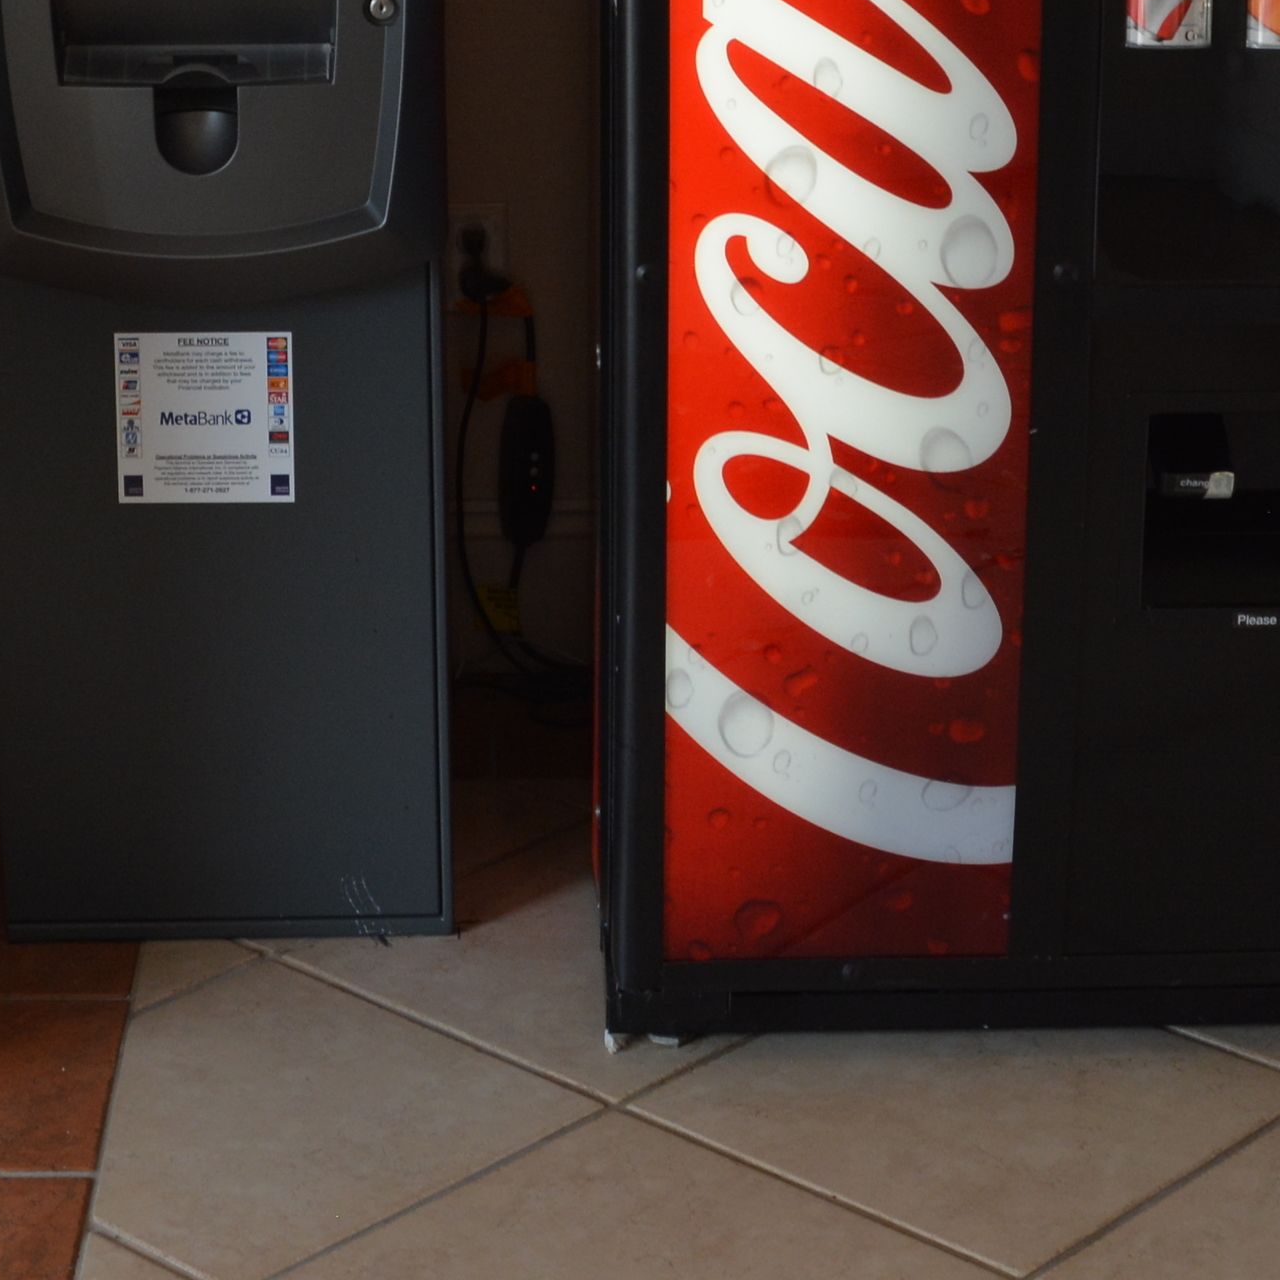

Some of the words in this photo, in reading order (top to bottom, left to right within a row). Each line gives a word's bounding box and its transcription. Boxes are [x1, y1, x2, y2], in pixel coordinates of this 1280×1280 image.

[177, 337, 196, 346] FEE
[197, 337, 229, 346] NOTICE
[160, 408, 233, 426] MetaBank
[1180, 478, 1210, 490] chang
[1237, 614, 1277, 626] Please
